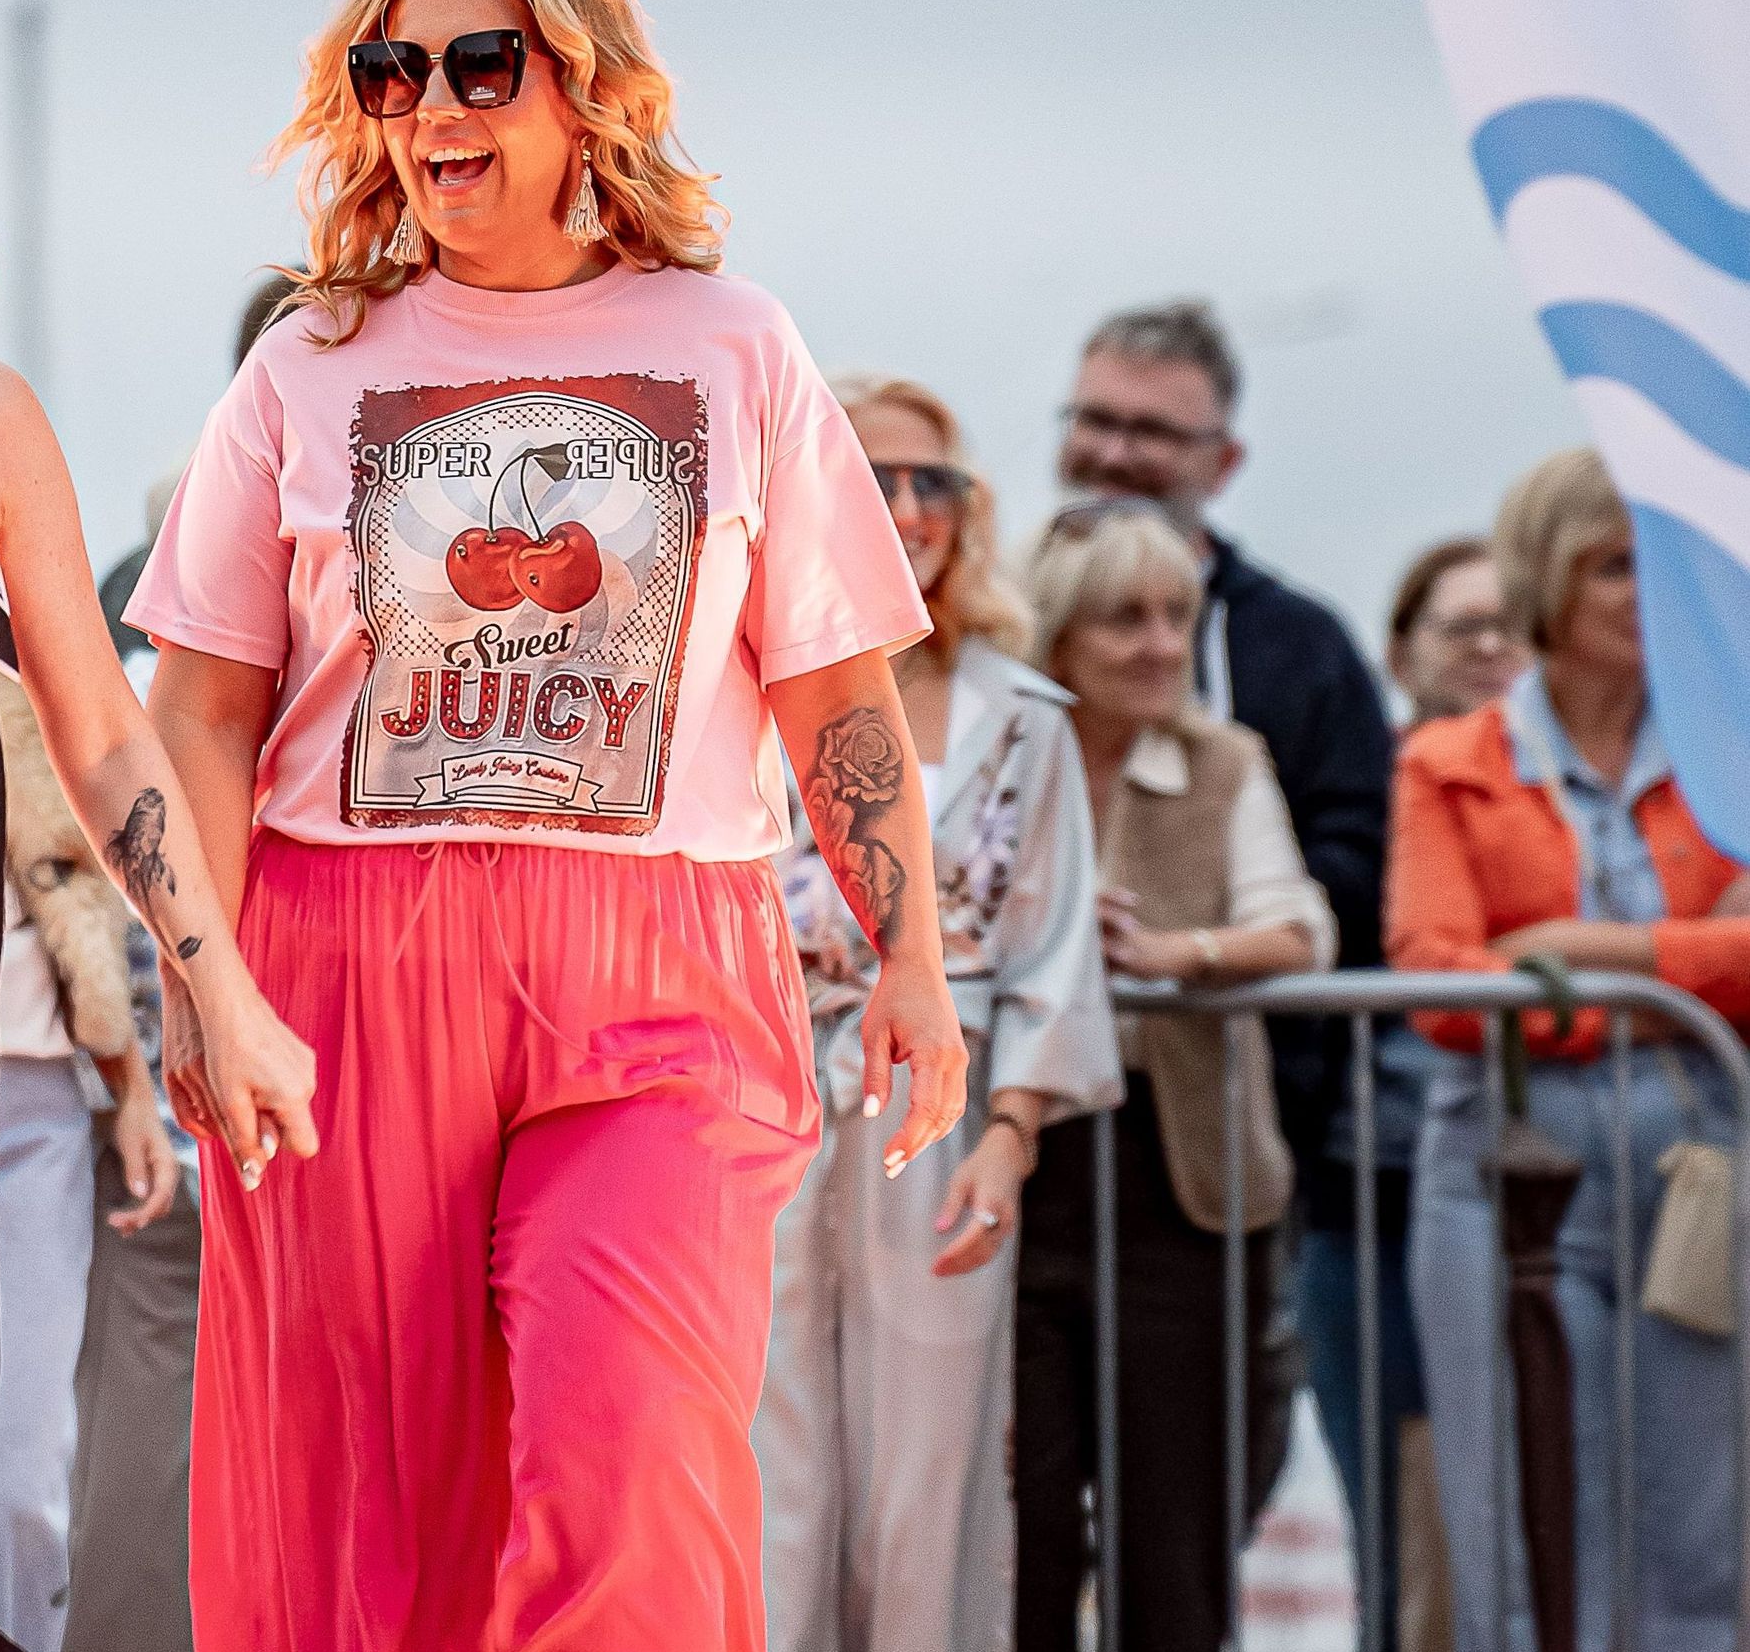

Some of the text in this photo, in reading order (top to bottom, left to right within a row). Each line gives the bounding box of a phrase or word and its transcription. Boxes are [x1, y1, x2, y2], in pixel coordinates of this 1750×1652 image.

[360, 442, 492, 487] SUPER
[443, 622, 575, 677] Sweet
[378, 667, 652, 751] JUICY
